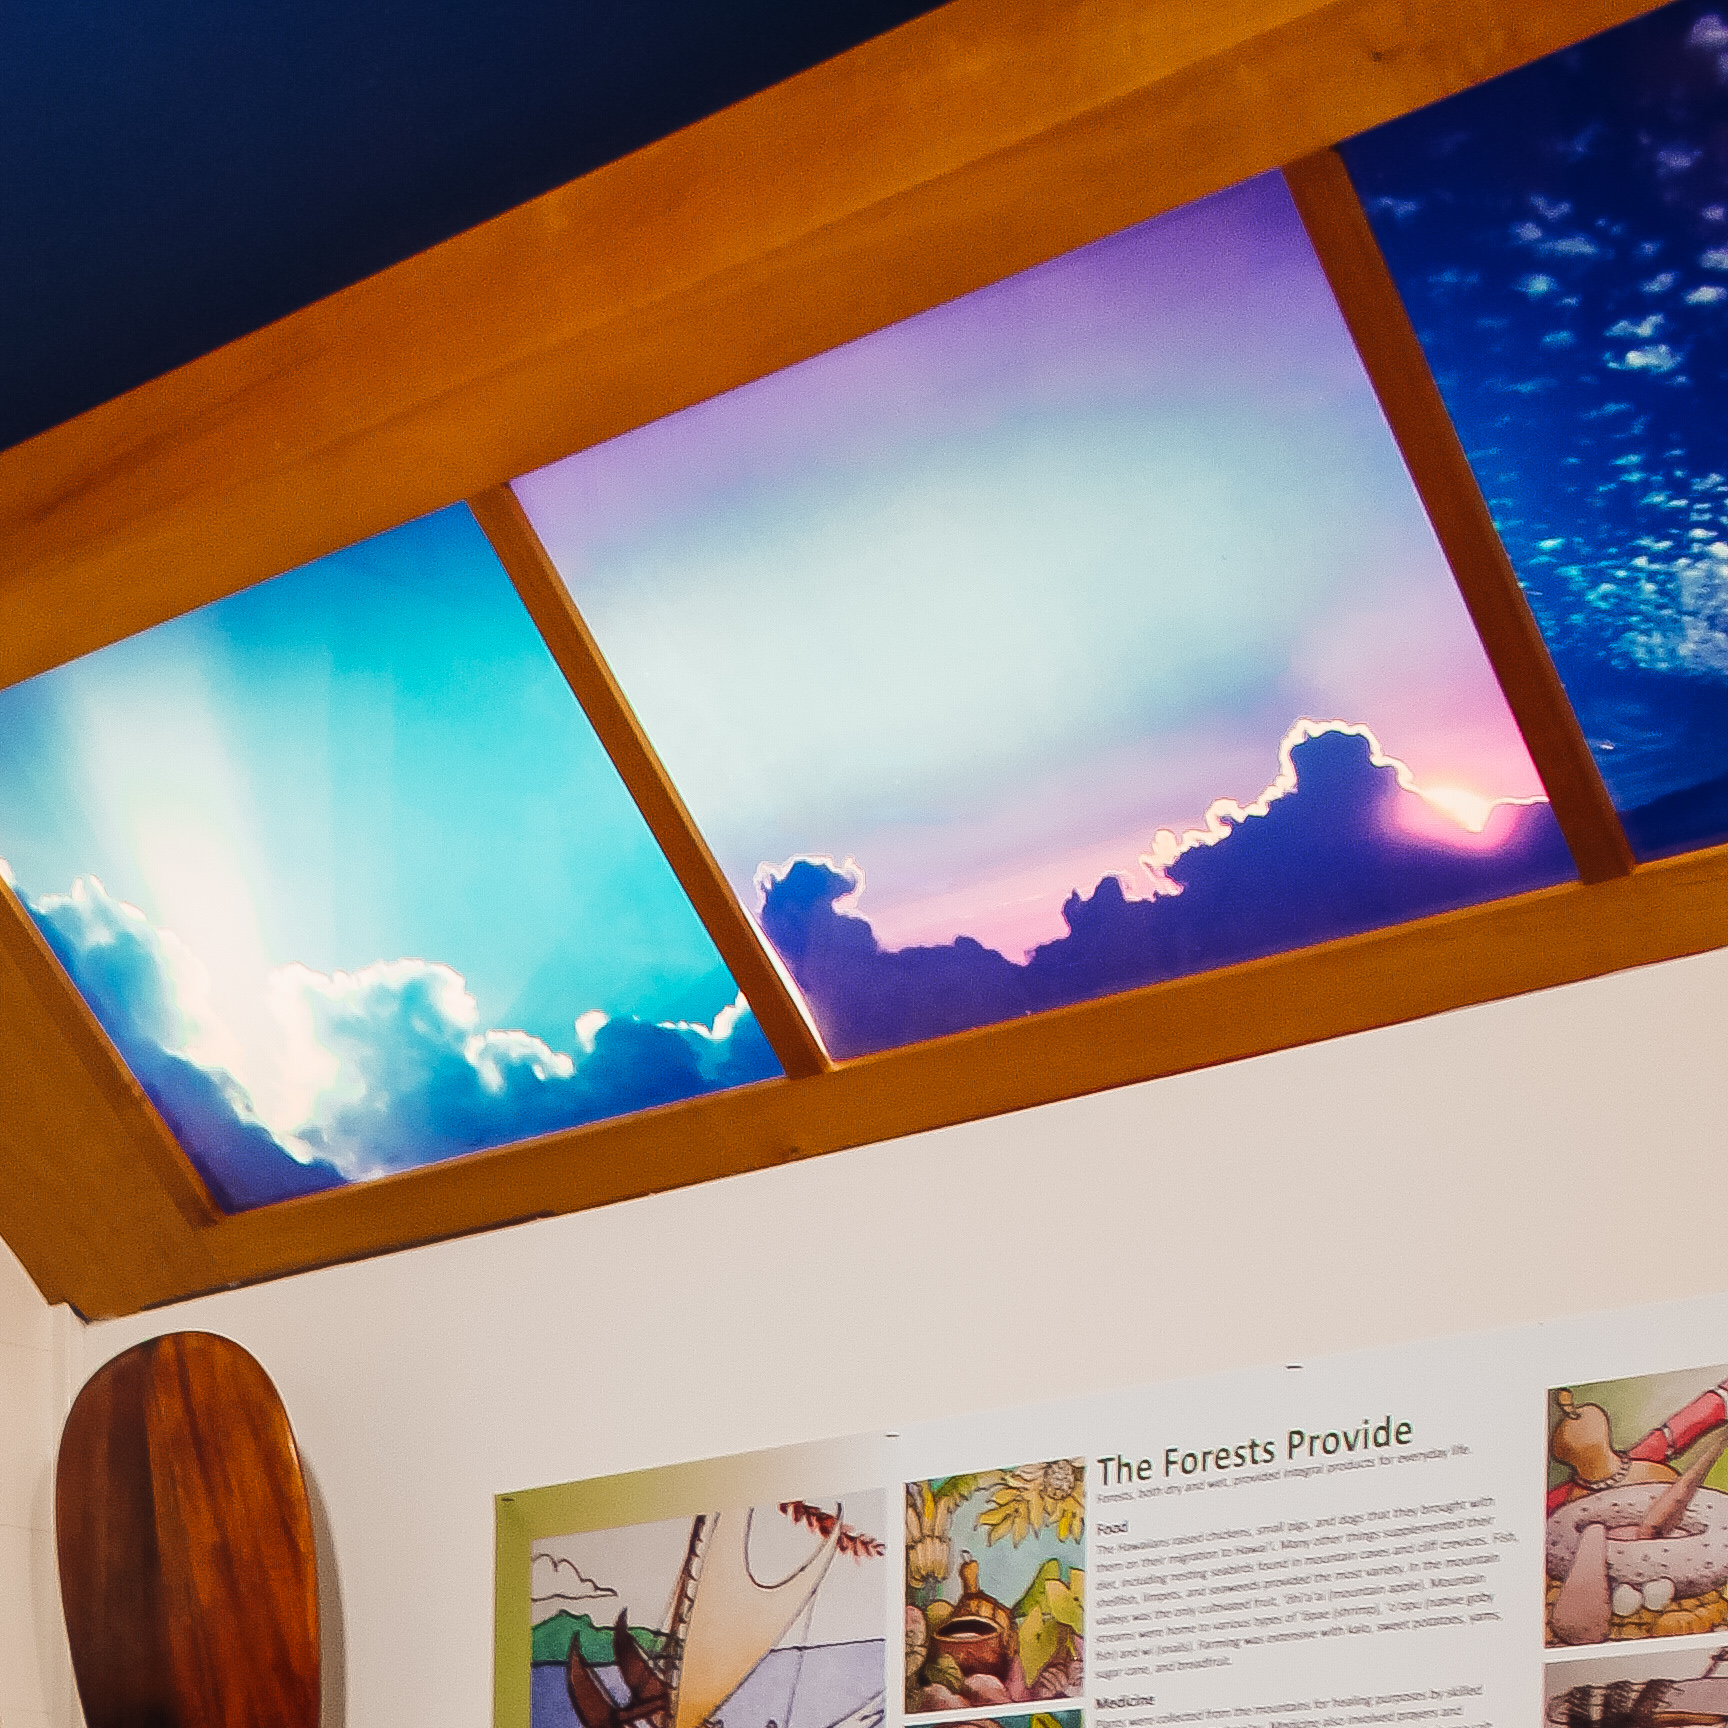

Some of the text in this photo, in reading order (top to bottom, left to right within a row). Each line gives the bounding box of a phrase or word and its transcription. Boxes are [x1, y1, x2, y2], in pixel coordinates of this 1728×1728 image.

[1098, 1415, 1413, 1485] The Forests Provide
[1139, 1485, 1162, 1497] both
[1165, 1484, 1182, 1495] dry
[1186, 1479, 1204, 1491] and
[1234, 1470, 1280, 1488] provided
[1284, 1464, 1323, 1479] integral
[1327, 1459, 1375, 1476] products
[1380, 1456, 1394, 1466] for
[1397, 1450, 1447, 1464] everyday
[1096, 1521, 1129, 1536] Food
[1095, 1694, 1155, 1710] Medicine
